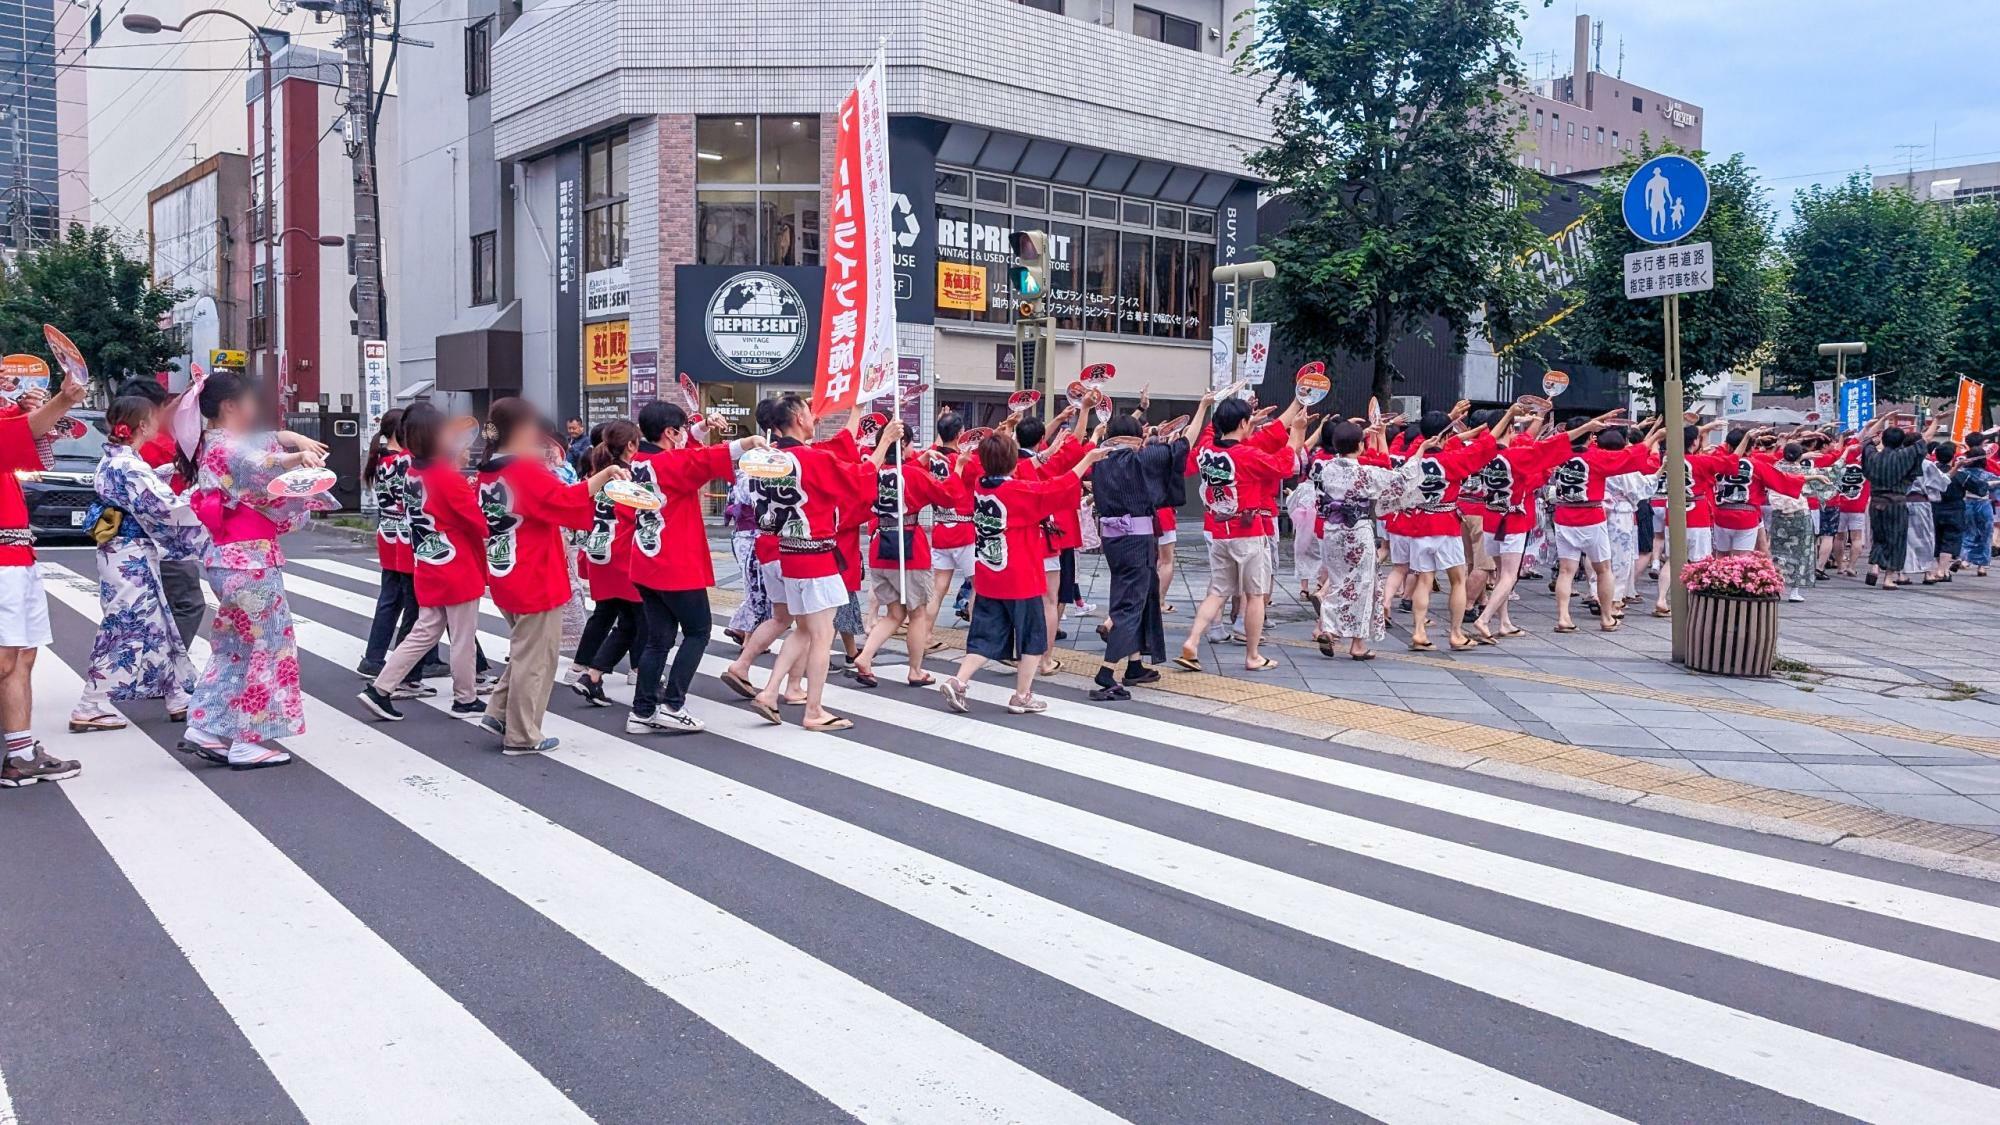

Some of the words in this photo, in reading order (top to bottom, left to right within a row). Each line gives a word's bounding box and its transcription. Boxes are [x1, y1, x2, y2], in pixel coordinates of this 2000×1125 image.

[1227, 207, 1236, 242] BUY
[975, 251, 982, 260] &
[984, 252, 1005, 263] USED
[1226, 246, 1236, 258] &
[1632, 249, 1704, 273] 歩行者用道路
[1630, 269, 1707, 294] 指定車・許可車を除く
[713, 318, 799, 333] REPRESENT
[368, 360, 382, 416] 中本商事
[706, 407, 750, 416] REPRESENT
[861, 416, 880, 436] 祭
